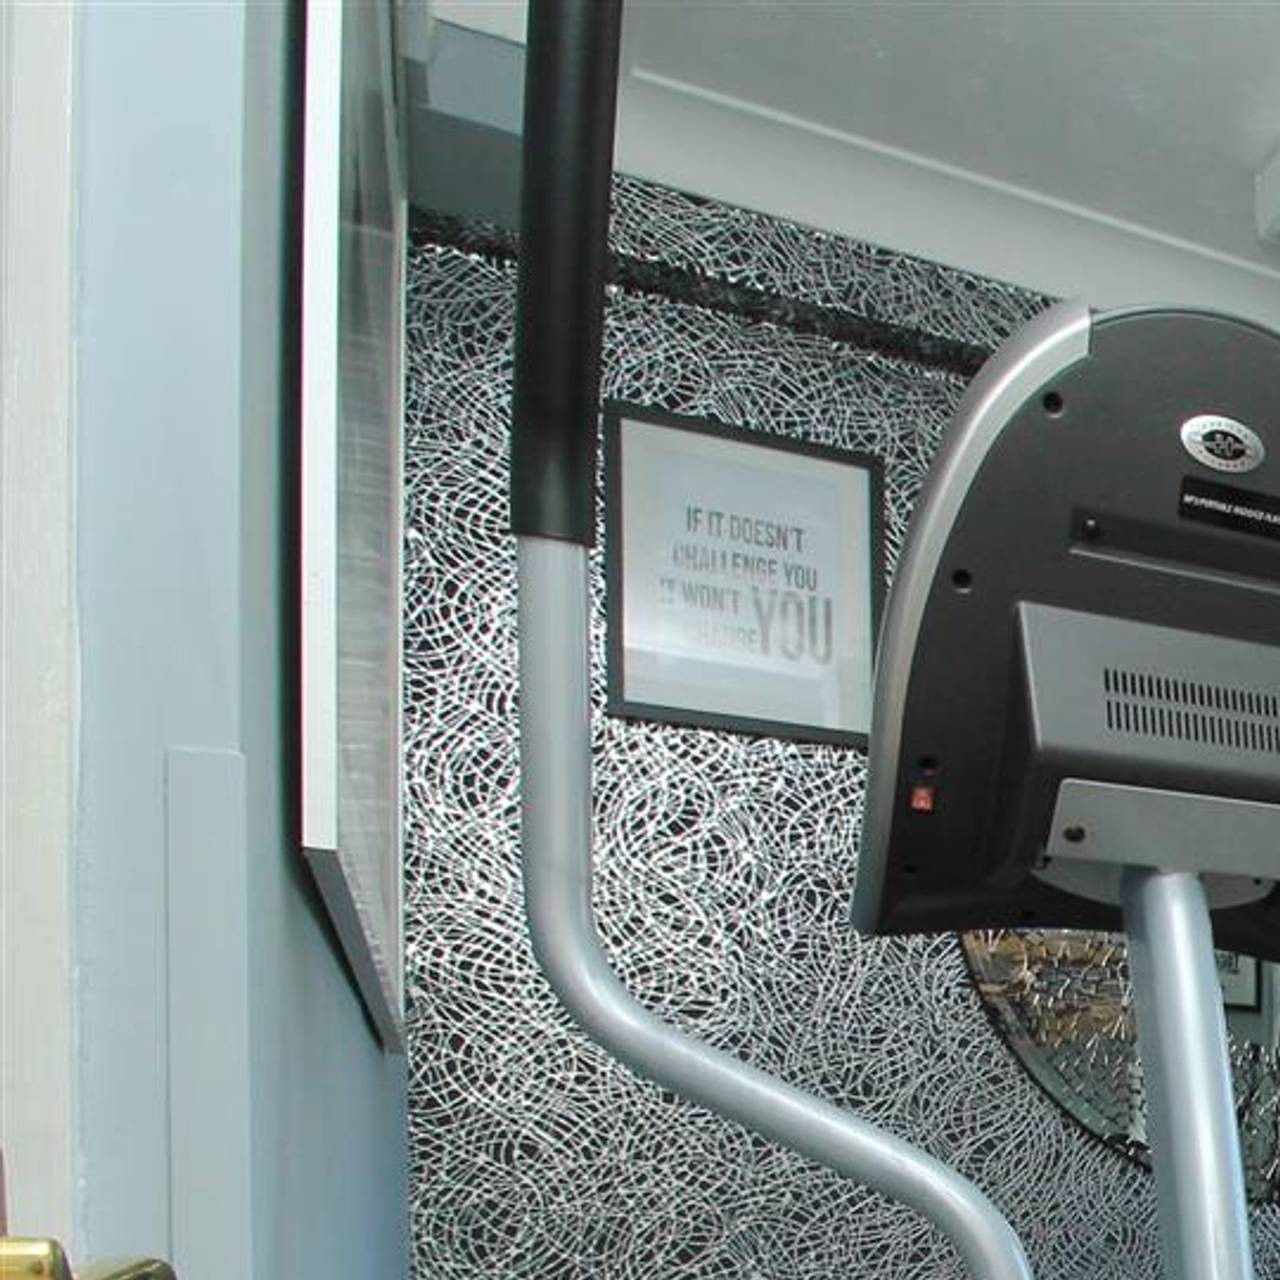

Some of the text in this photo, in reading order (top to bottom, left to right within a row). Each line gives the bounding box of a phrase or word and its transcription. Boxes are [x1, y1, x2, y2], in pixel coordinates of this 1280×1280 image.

[686, 505, 806, 553] IF IT DOESN'T
[682, 580, 741, 614] WON'T
[785, 562, 818, 592] YOU
[750, 585, 834, 666] YOU
